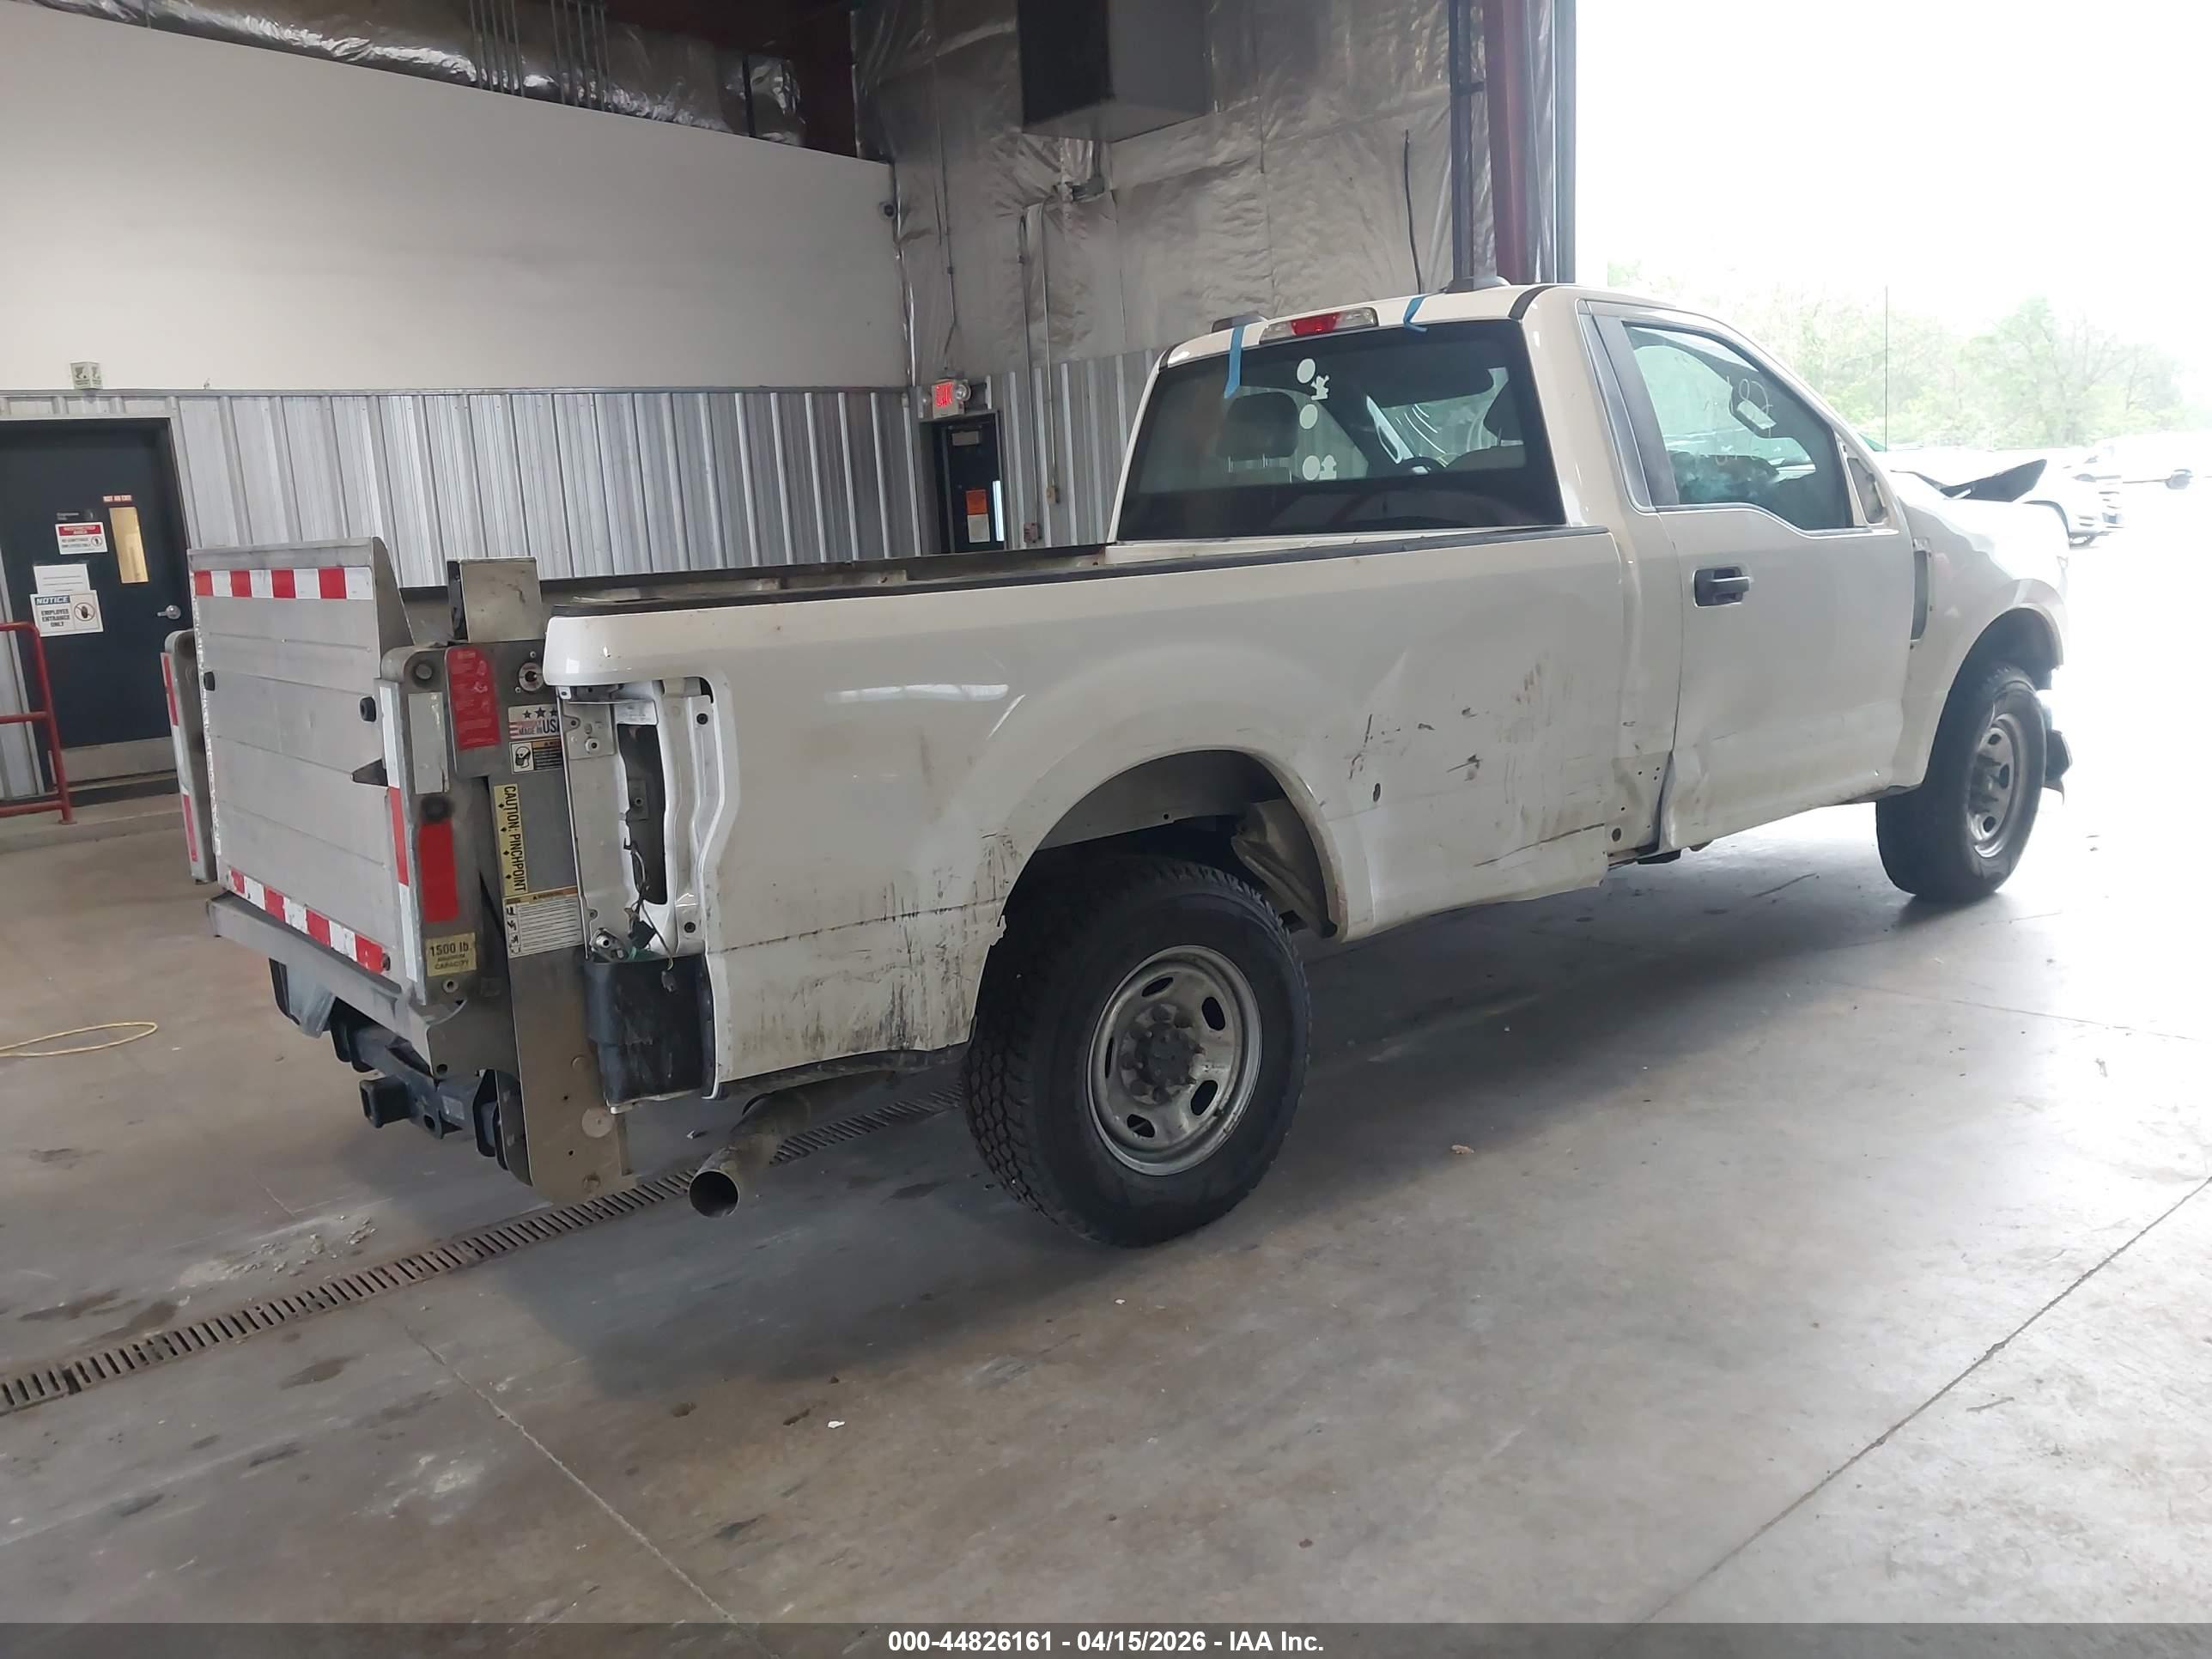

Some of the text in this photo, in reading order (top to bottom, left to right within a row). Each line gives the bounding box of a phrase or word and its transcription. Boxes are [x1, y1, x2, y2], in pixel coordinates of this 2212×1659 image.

[543, 718, 560, 733] US
[504, 786, 520, 832] CAUTION:
[508, 833, 526, 891] PINCHPOINT
[429, 943, 456, 957] 1500
[434, 959, 469, 969] CAPACITY
